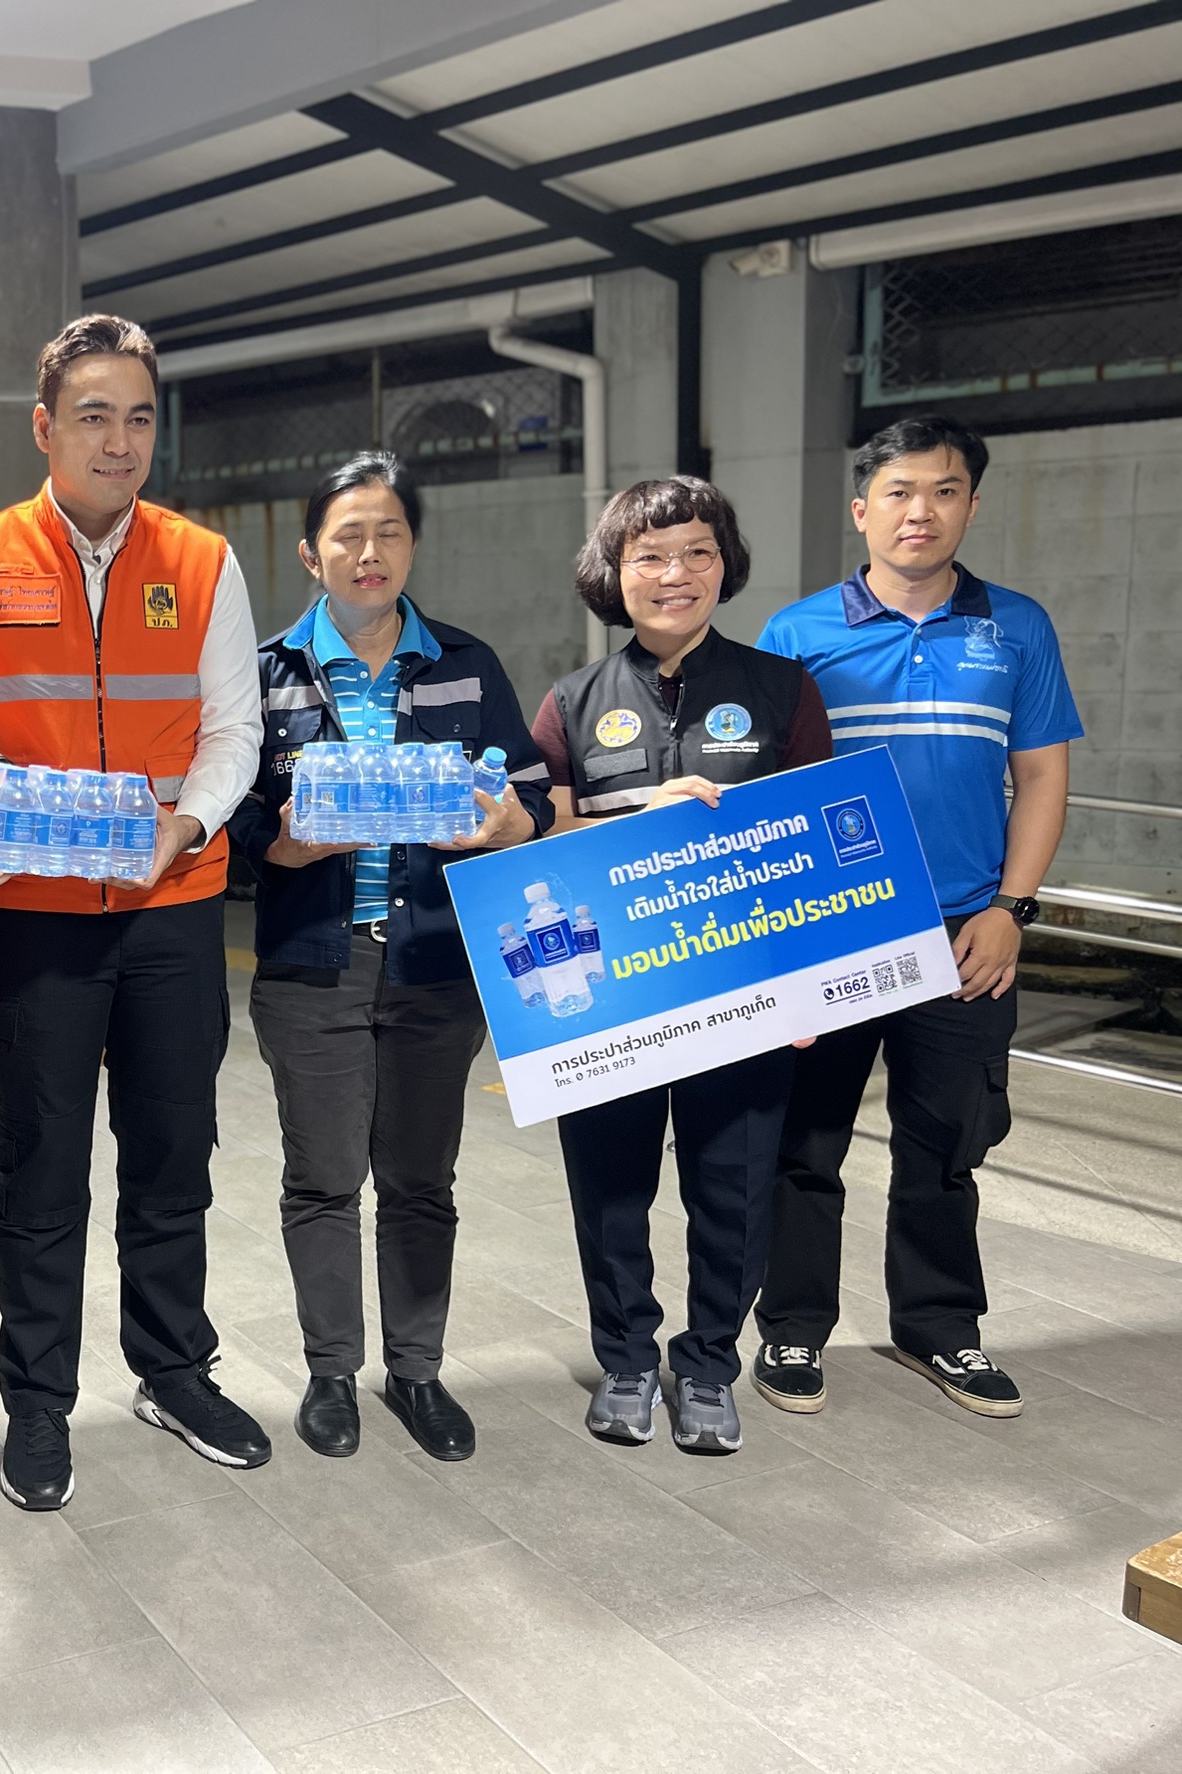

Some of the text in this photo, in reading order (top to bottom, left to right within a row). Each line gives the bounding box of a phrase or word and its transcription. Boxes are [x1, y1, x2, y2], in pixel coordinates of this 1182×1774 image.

[609, 813, 810, 886] การประปาส่วนภูมิภาค
[626, 852, 814, 921] เติมน้ำใจใส่น้ำประปา
[612, 878, 896, 979] มอบน้ำดื่มเพื่อประชาชน
[835, 976, 871, 997] 1662
[551, 994, 777, 1074] การประปาส่วนภูมิภาค สาขาภูเก็ต
[555, 1056, 637, 1088] โทร. 0 7631 9173
